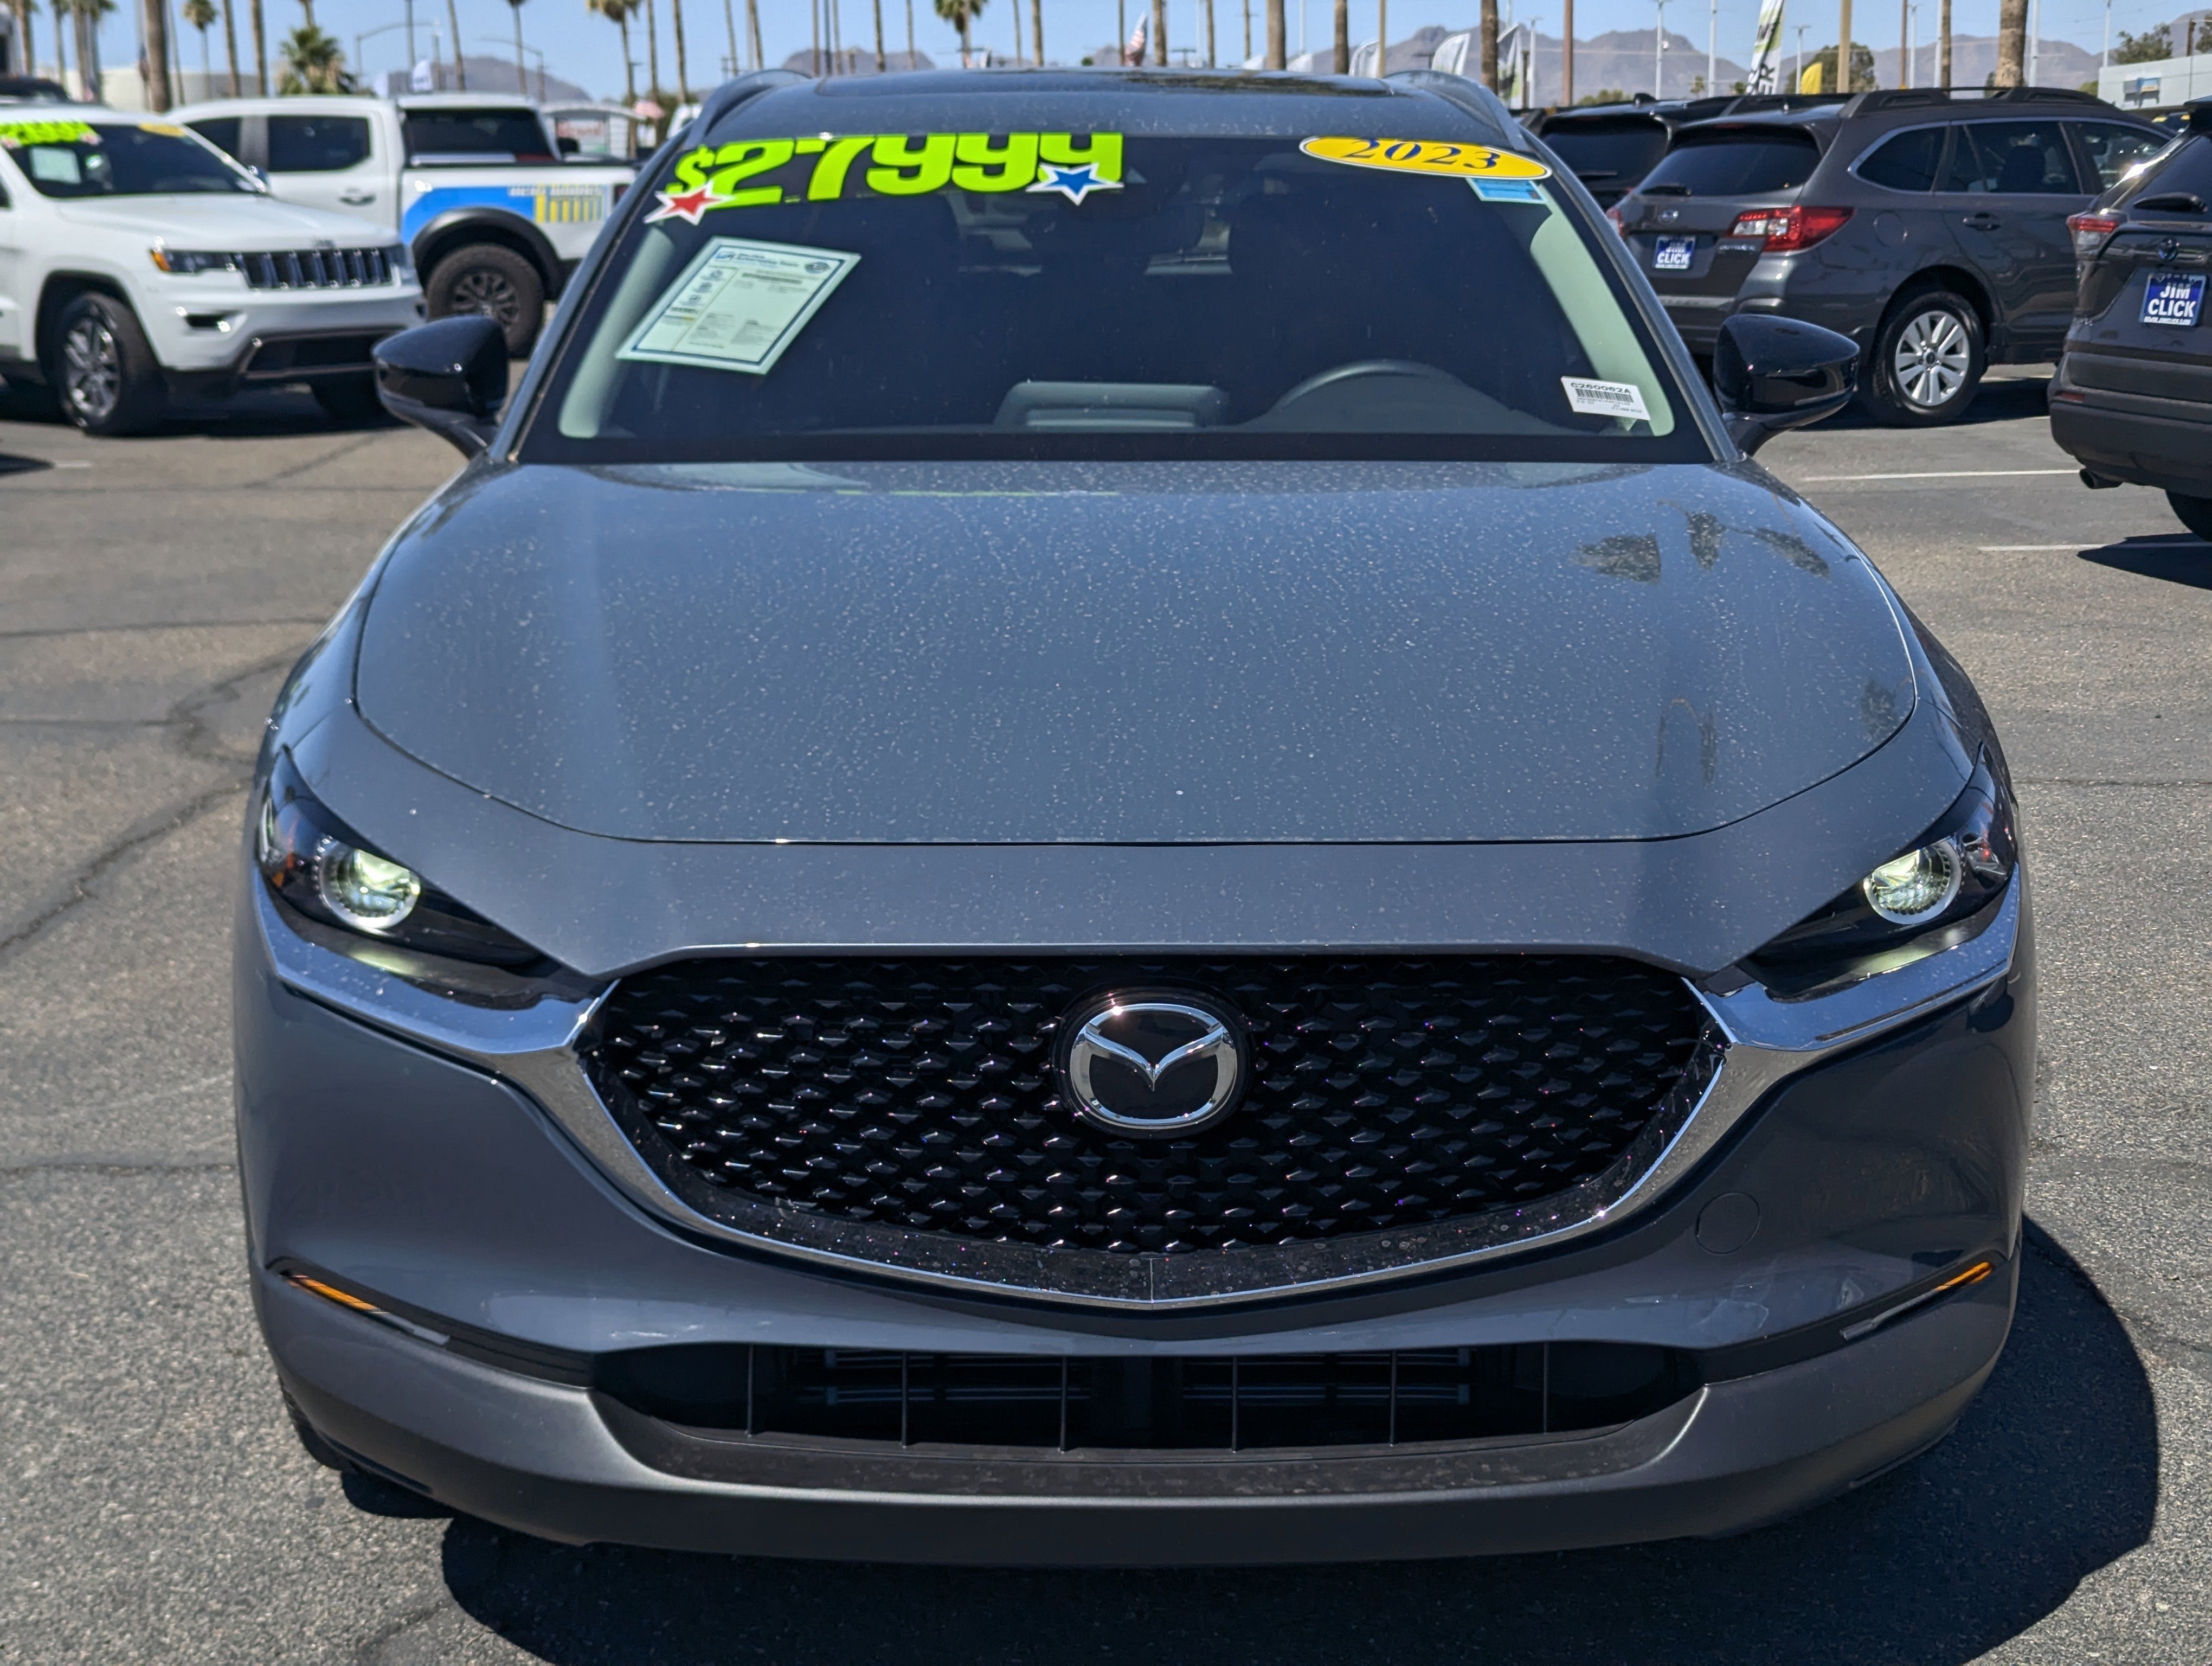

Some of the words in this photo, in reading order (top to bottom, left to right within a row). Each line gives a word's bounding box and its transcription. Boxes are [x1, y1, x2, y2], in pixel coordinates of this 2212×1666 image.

[1340, 139, 1501, 170] 2023
[1657, 251, 1690, 264] CLICK
[2160, 283, 2191, 299] JIM
[2147, 298, 2197, 317] CLICK
